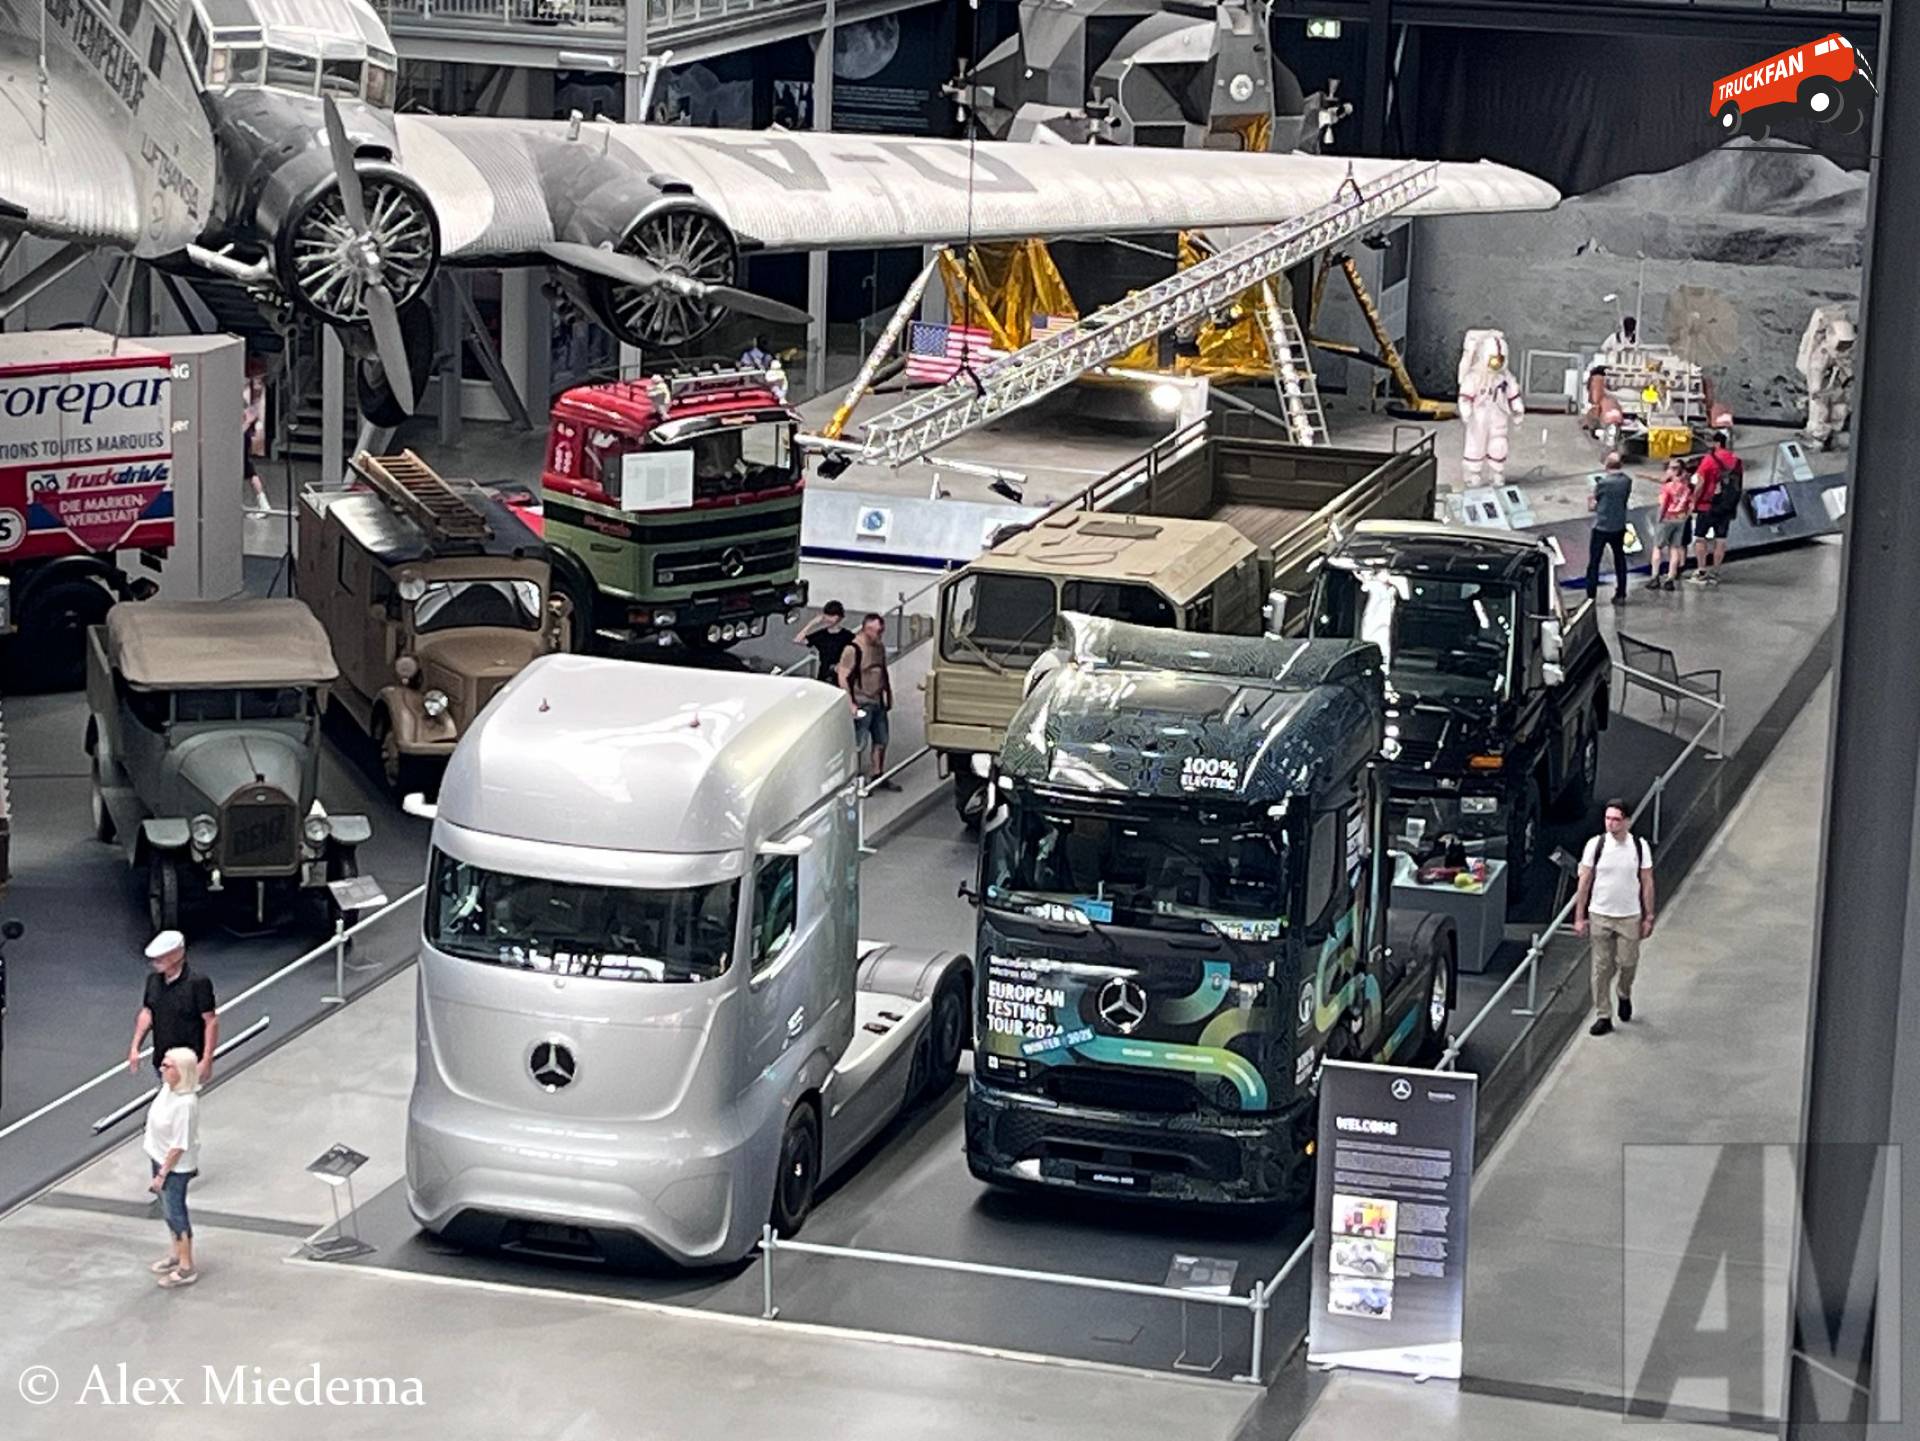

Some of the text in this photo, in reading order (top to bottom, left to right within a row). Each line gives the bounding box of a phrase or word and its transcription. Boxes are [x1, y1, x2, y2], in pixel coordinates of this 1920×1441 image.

[42, 437, 92, 457] TOUTES
[97, 431, 164, 451] MARQUES
[66, 463, 170, 490] truckdrive
[59, 497, 83, 514] DIE
[63, 508, 140, 527] WERKSTATT
[1182, 756, 1238, 778] 100%
[1180, 774, 1237, 791] ELECTRIC
[988, 980, 1065, 1008] EUROPEAN
[987, 997, 1047, 1022] TESTING
[986, 1014, 1024, 1037] TOUR
[1336, 1116, 1398, 1135] WELCOME
